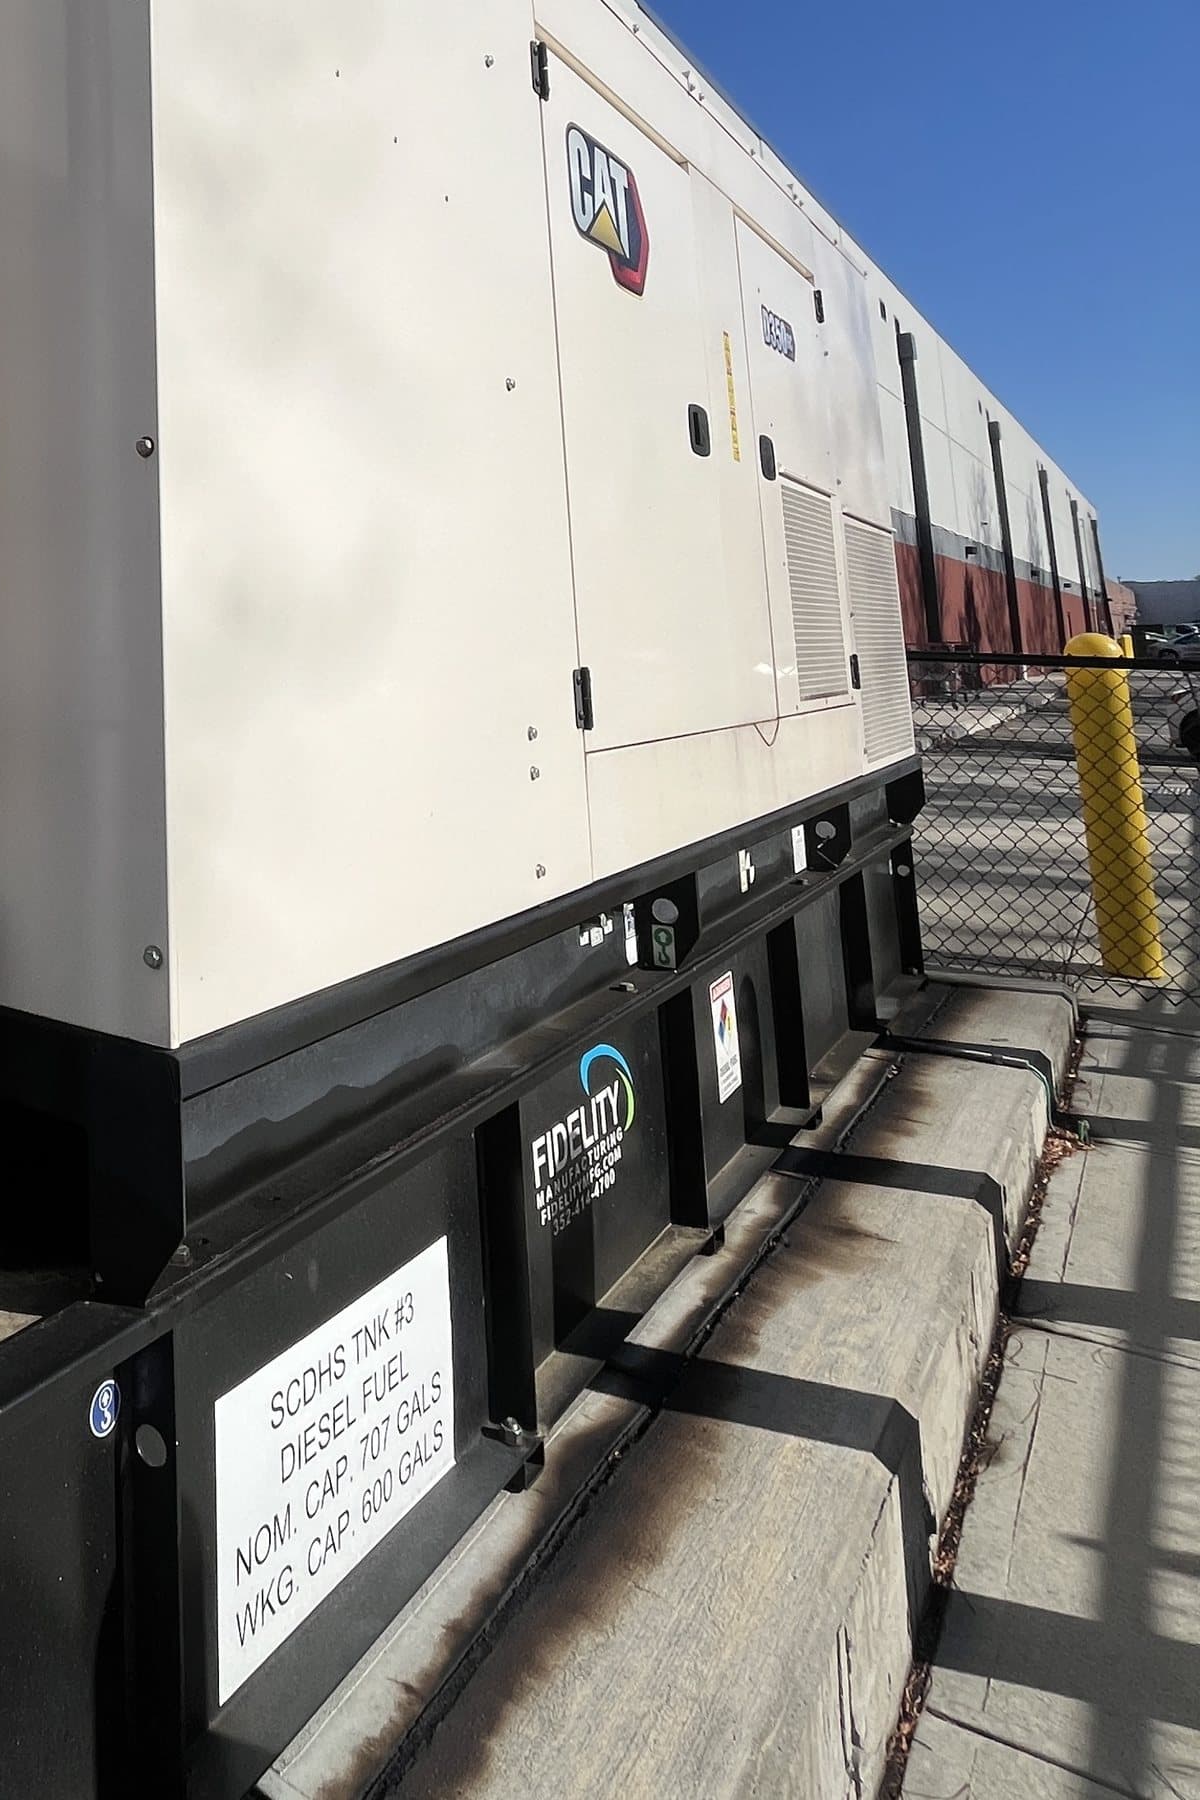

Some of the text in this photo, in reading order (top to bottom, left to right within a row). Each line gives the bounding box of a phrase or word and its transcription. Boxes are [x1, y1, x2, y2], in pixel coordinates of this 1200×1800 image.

[568, 128, 630, 259] CAT
[531, 1079, 619, 1189] FIDELITY
[535, 1126, 624, 1210] MANUFACTURING
[540, 1145, 623, 1226] FIDELITYMFG.COM
[552, 1167, 616, 1236] 352-414-4700
[270, 1292, 416, 1429] SCDHS TNK #3
[280, 1350, 410, 1484] DIESEL FUEL
[235, 1371, 442, 1586] NOM. CAP. 707 GALS
[235, 1420, 444, 1648] WKG. CAP. 600 GALS
